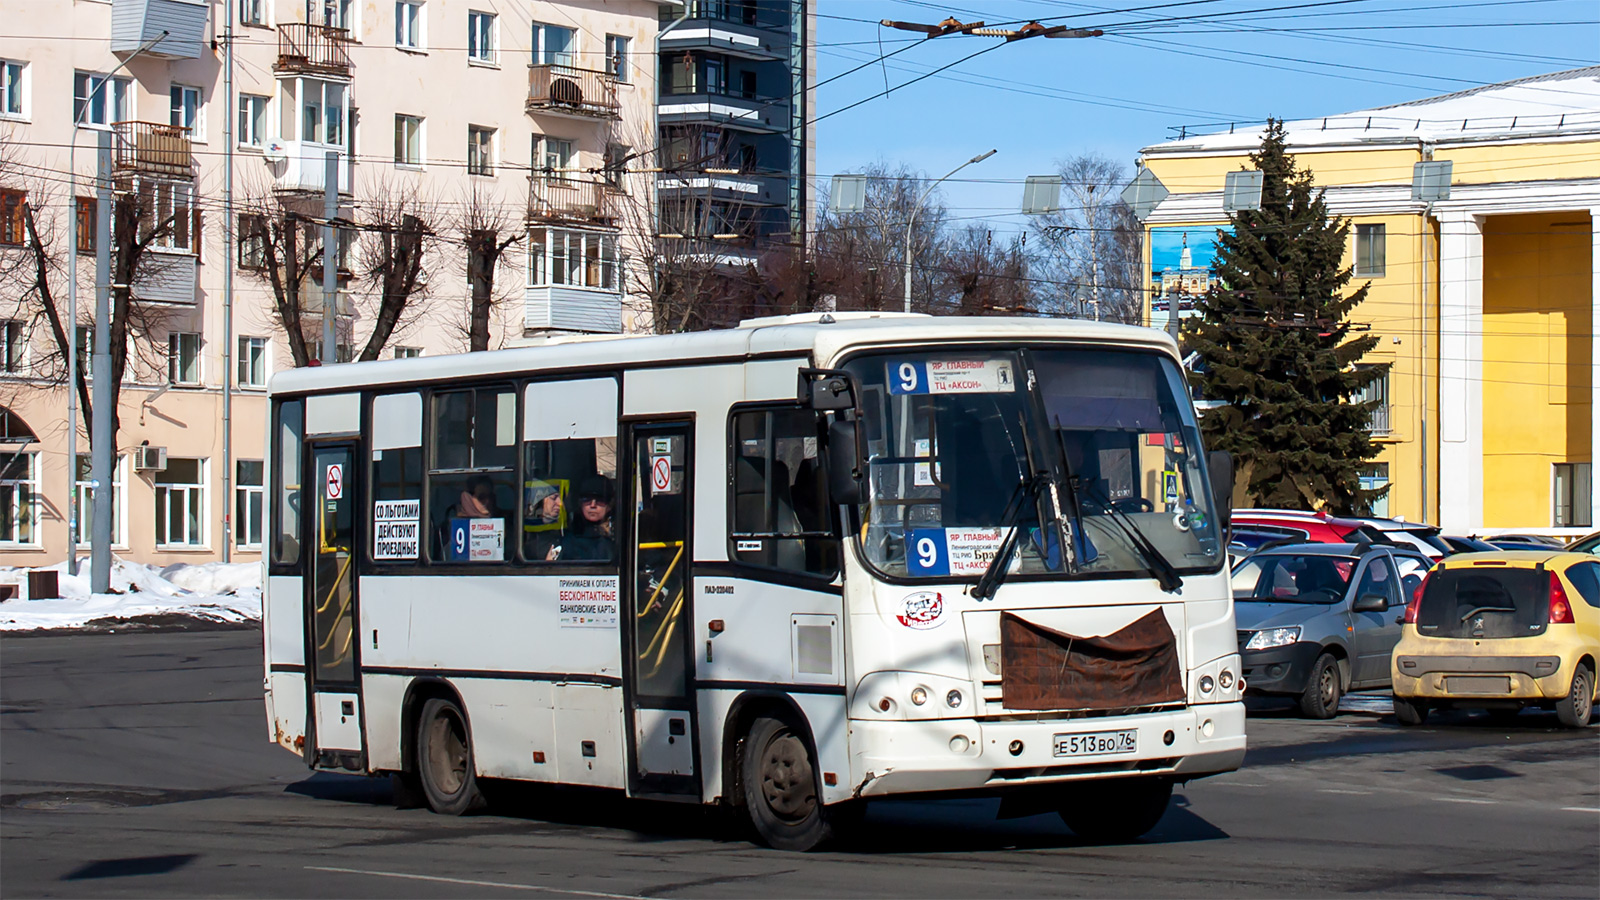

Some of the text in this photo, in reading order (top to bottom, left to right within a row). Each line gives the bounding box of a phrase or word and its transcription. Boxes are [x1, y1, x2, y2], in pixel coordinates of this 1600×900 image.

[946, 361, 985, 370] ГЛАВНЫЙ
[898, 362, 918, 391] 9
[935, 381, 983, 391] ТЦ «АКСОН»
[376, 504, 419, 519] СО ЛЬГОТАМИ
[378, 522, 417, 541] ДЕЙСТВУЮТ
[963, 532, 1000, 541] ГЛАВНЫЙ
[456, 527, 465, 554] 9
[377, 542, 417, 558] ПРОЕЗДНЫЕ
[916, 537, 937, 568] 9
[953, 562, 964, 570] ТЦ
[559, 579, 591, 588] ПРИНИМАЕМ
[596, 579, 616, 587] ОПЛАТЕ
[560, 591, 616, 601] БЕСКОНТАКТНЫЕ
[560, 604, 616, 614] БАНКОВСКИЕ КАРТЫ
[1119, 733, 1132, 746] 76
